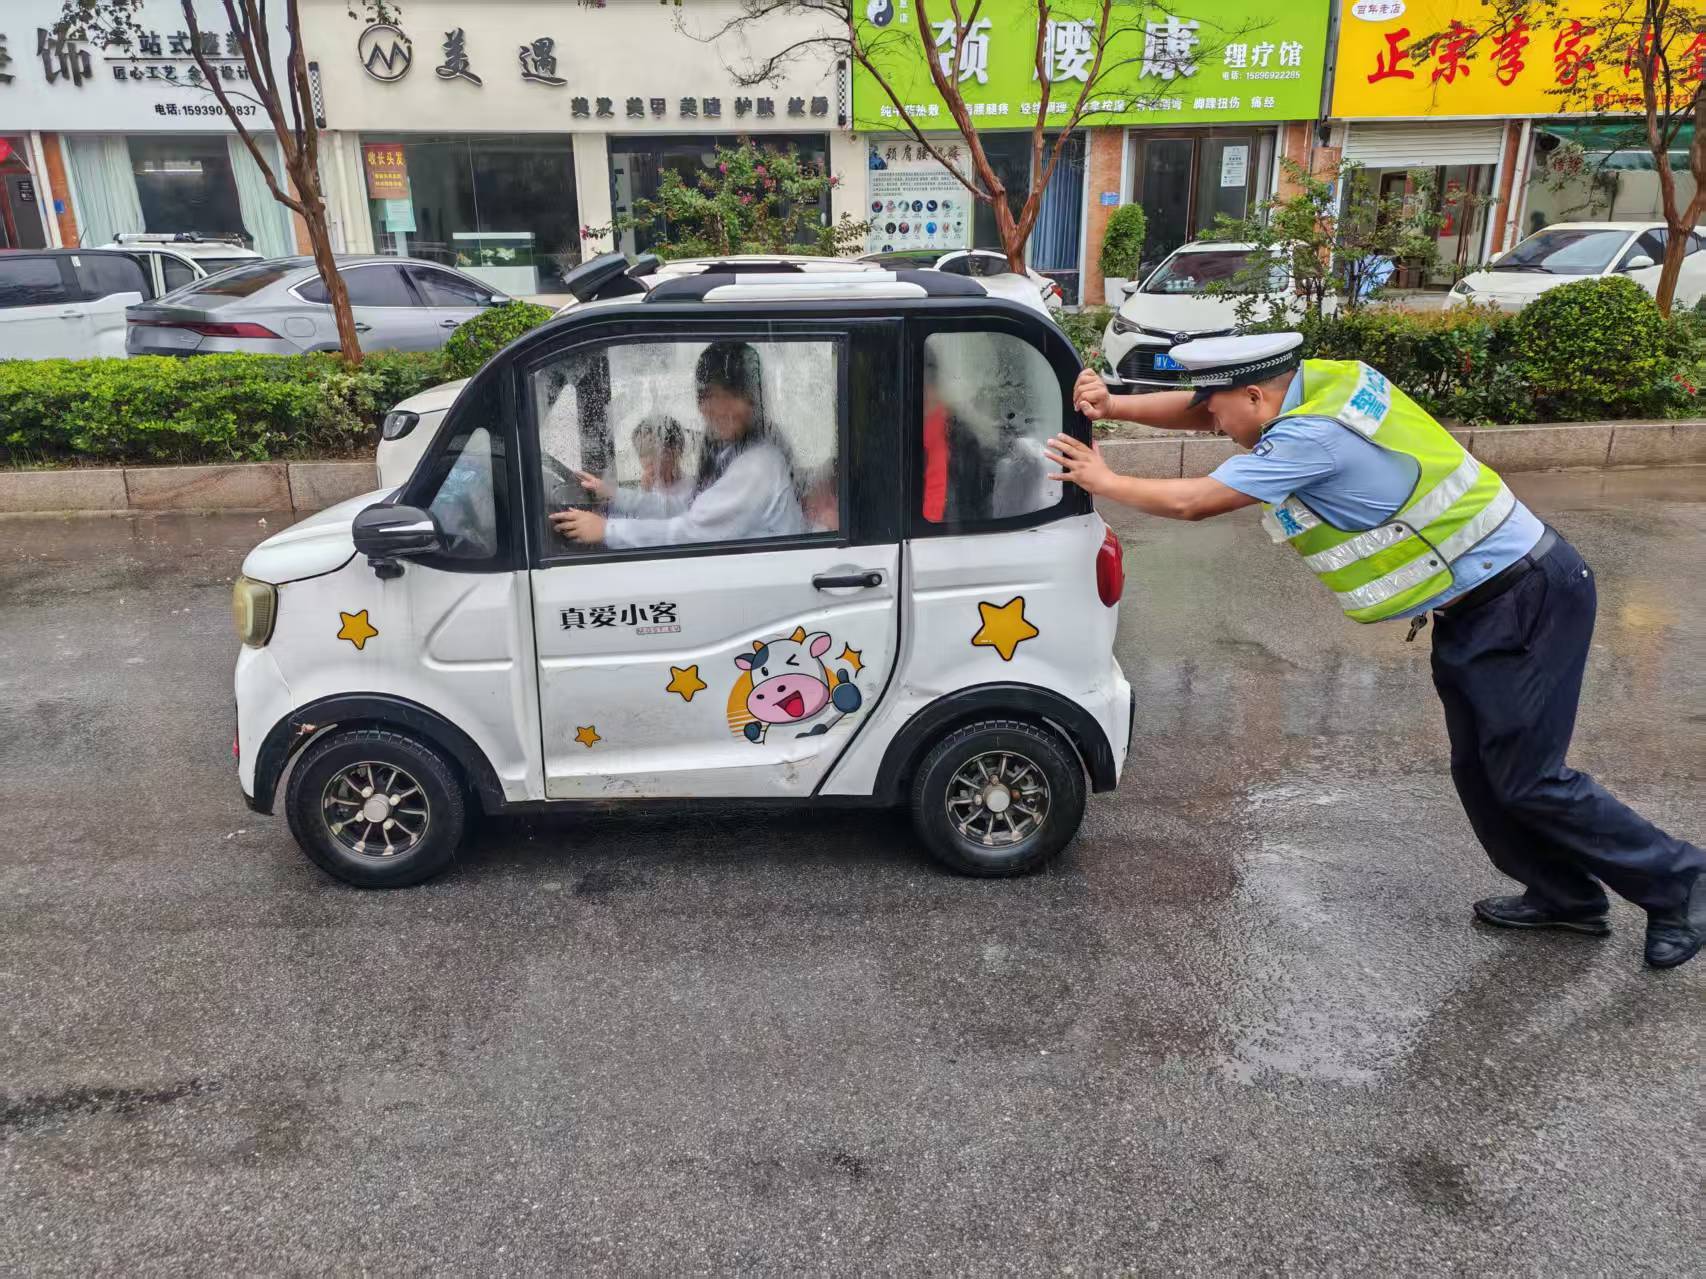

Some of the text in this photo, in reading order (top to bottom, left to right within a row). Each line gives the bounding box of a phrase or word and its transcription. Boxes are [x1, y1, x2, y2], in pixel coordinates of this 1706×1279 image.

[0, 27, 93, 88] 饰
[1223, 41, 1304, 69] 理疗馆
[112, 64, 249, 82] 匠心工艺 全设计
[154, 103, 257, 117] 电话:159390837
[626, 97, 666, 119] 美甲
[559, 602, 678, 630] 真爱小客
